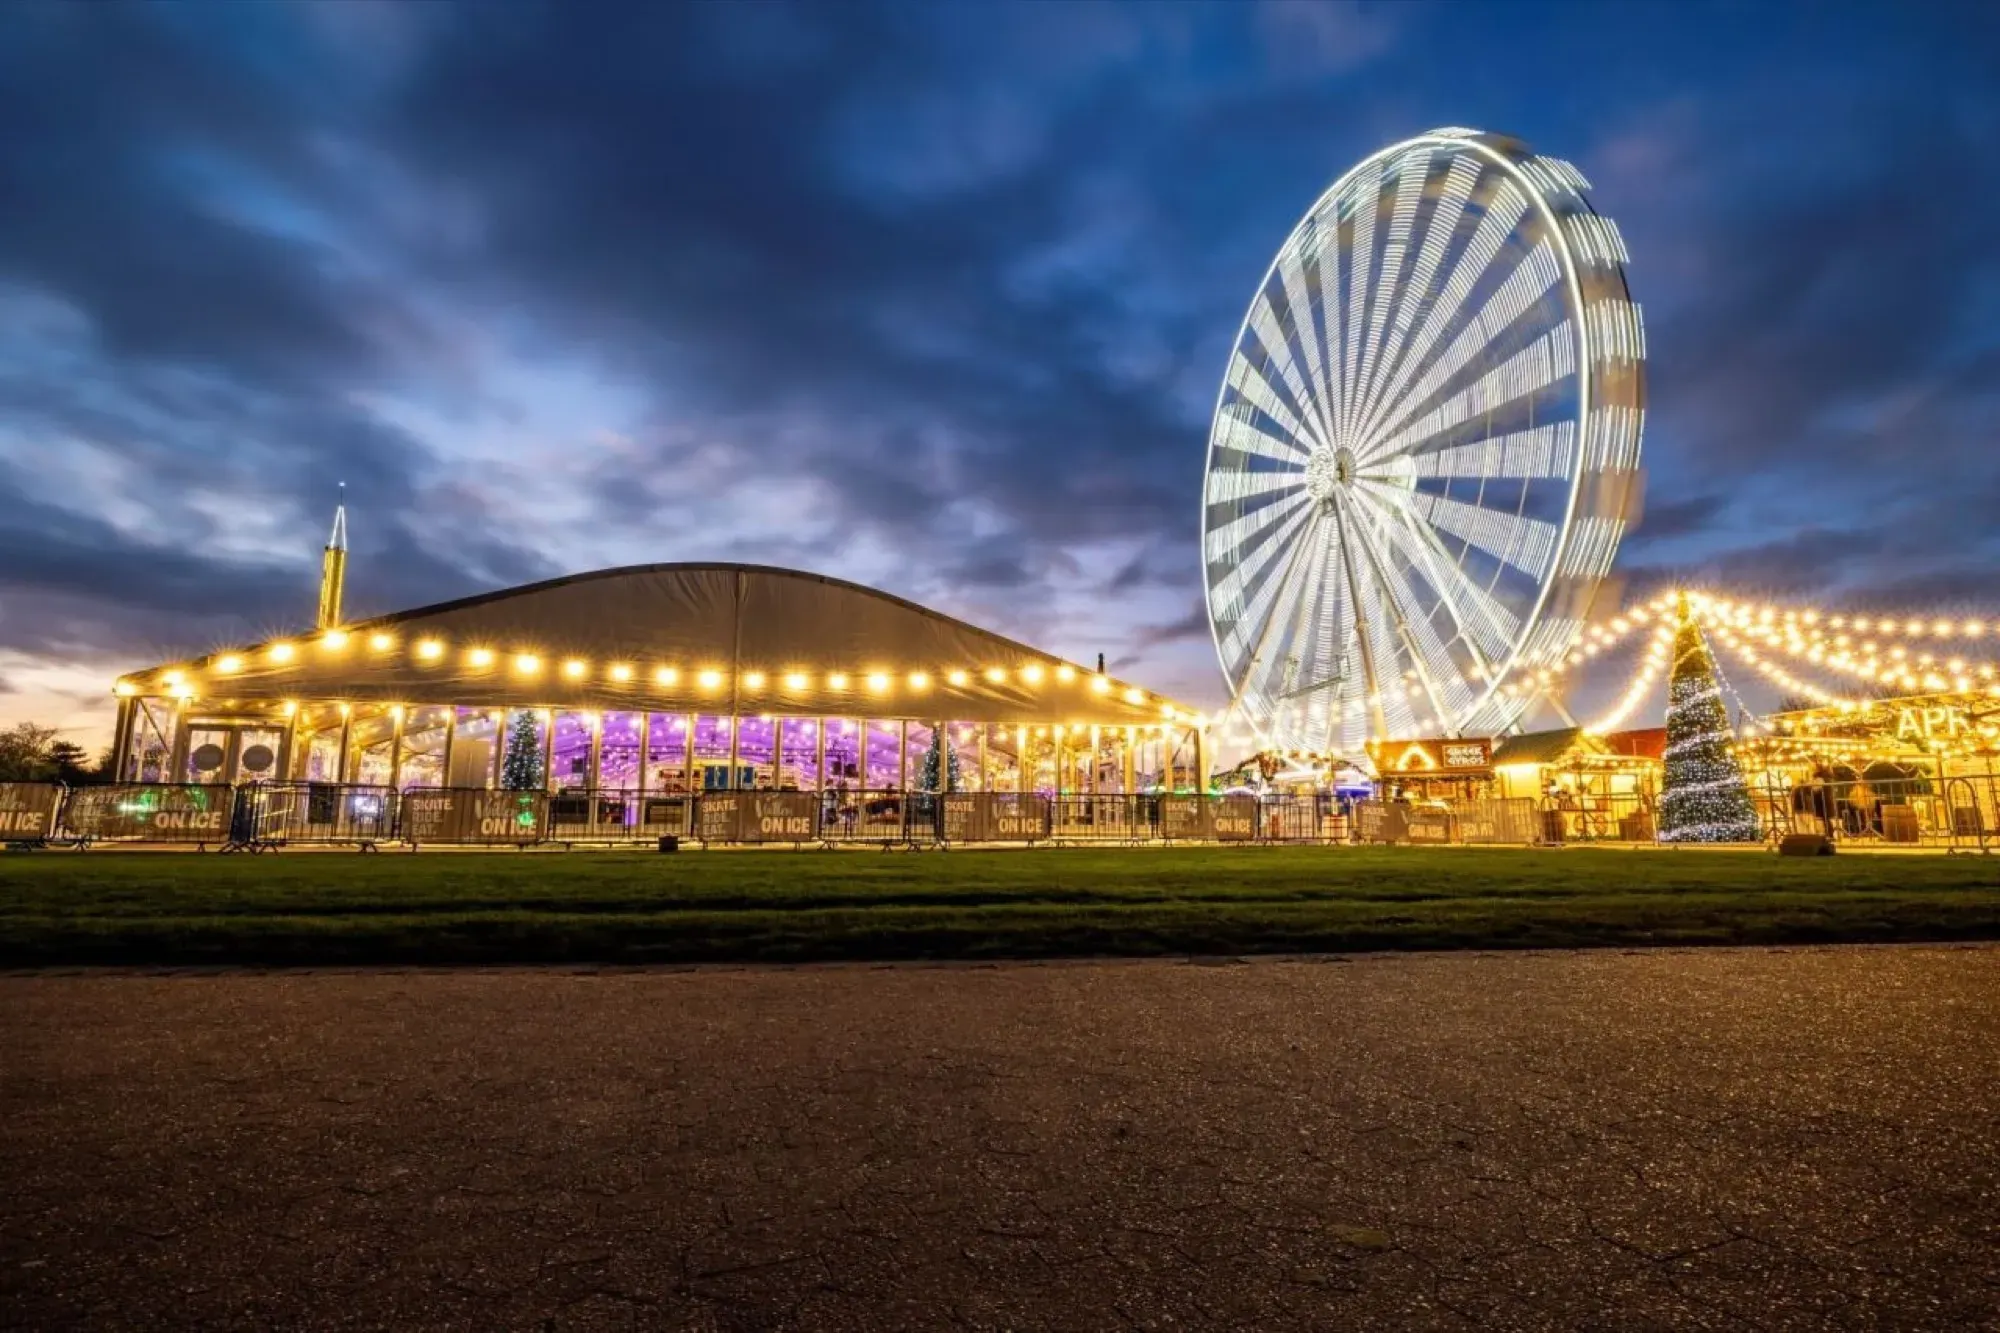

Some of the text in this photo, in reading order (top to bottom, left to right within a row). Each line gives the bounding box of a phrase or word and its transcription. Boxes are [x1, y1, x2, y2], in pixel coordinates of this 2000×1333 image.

[15, 811, 44, 831] ICE
[155, 811, 222, 829] ON ICE
[481, 818, 537, 836] ON ICE
[761, 816, 811, 834] ON ICE
[998, 818, 1043, 833] ON ICE
[1215, 818, 1251, 834] ON ICE
